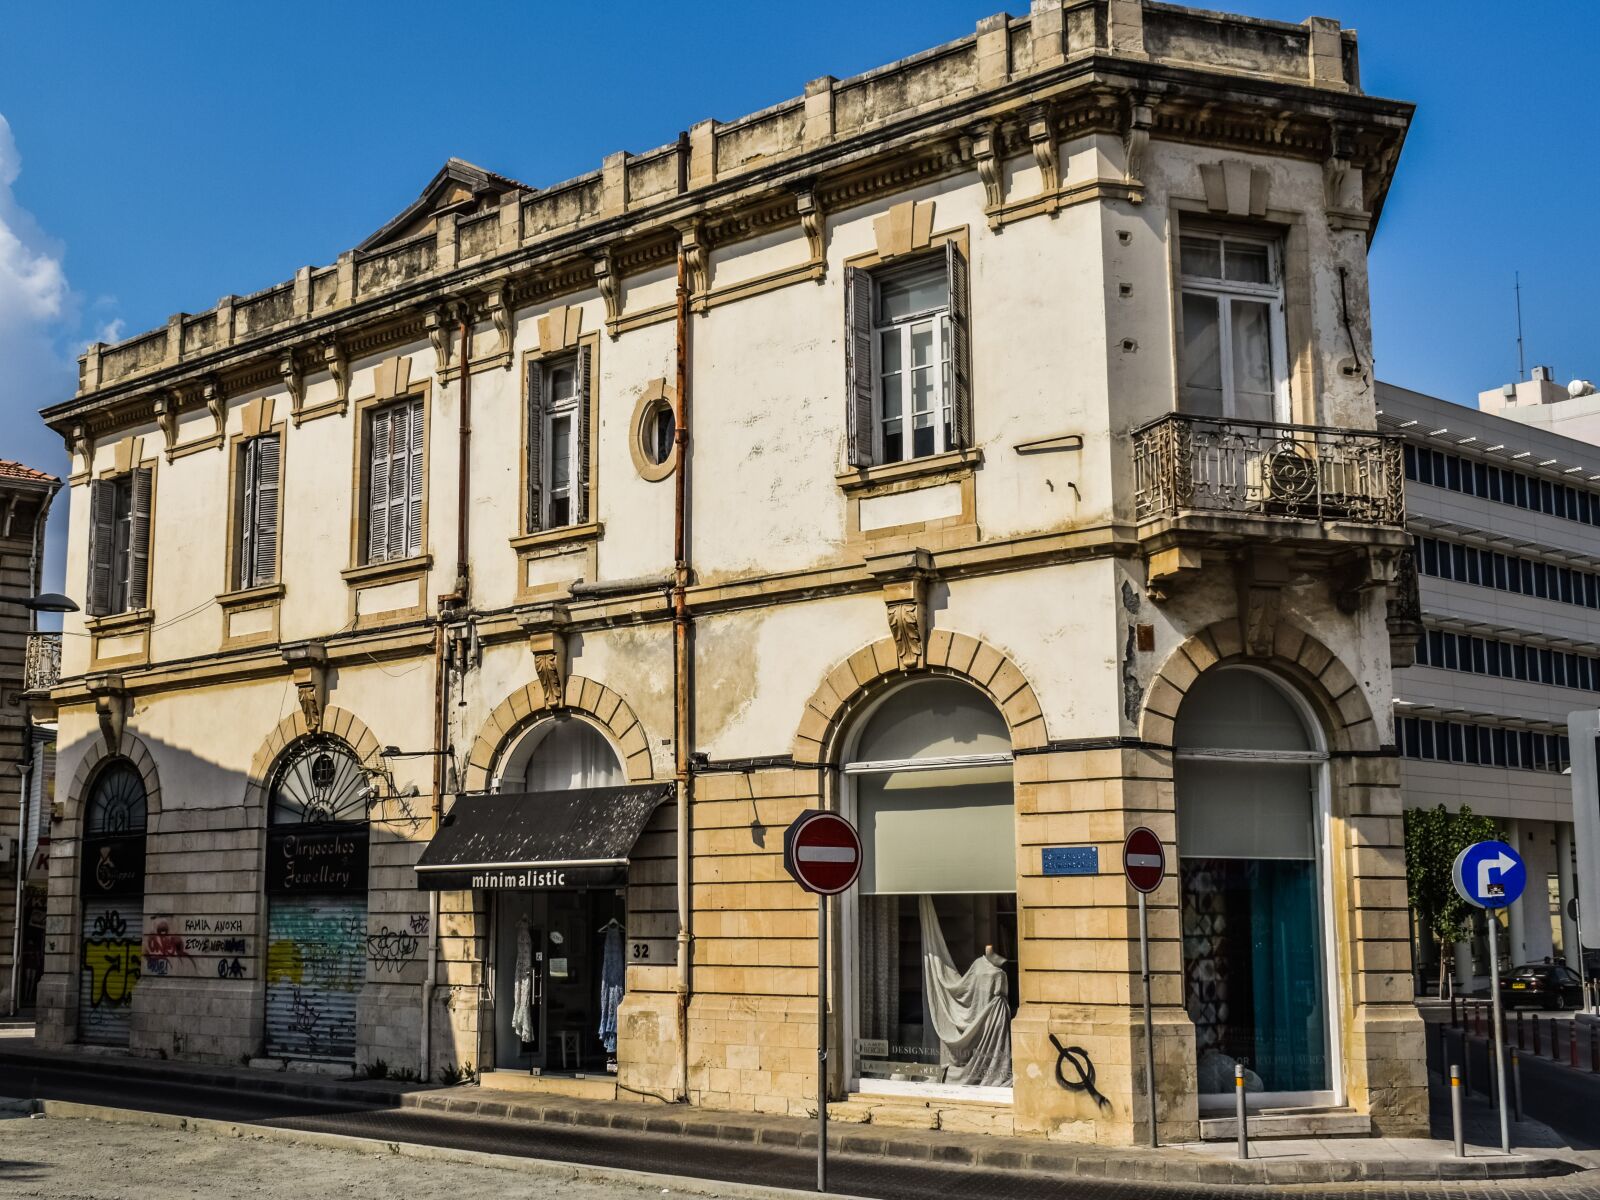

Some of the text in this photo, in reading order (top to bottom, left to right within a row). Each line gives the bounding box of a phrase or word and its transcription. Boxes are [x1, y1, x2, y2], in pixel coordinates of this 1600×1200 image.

[284, 861, 351, 888] Jewellery
[472, 869, 566, 888] minimalistic
[634, 943, 649, 958] 32
[892, 1045, 941, 1056] DESIGNERS
